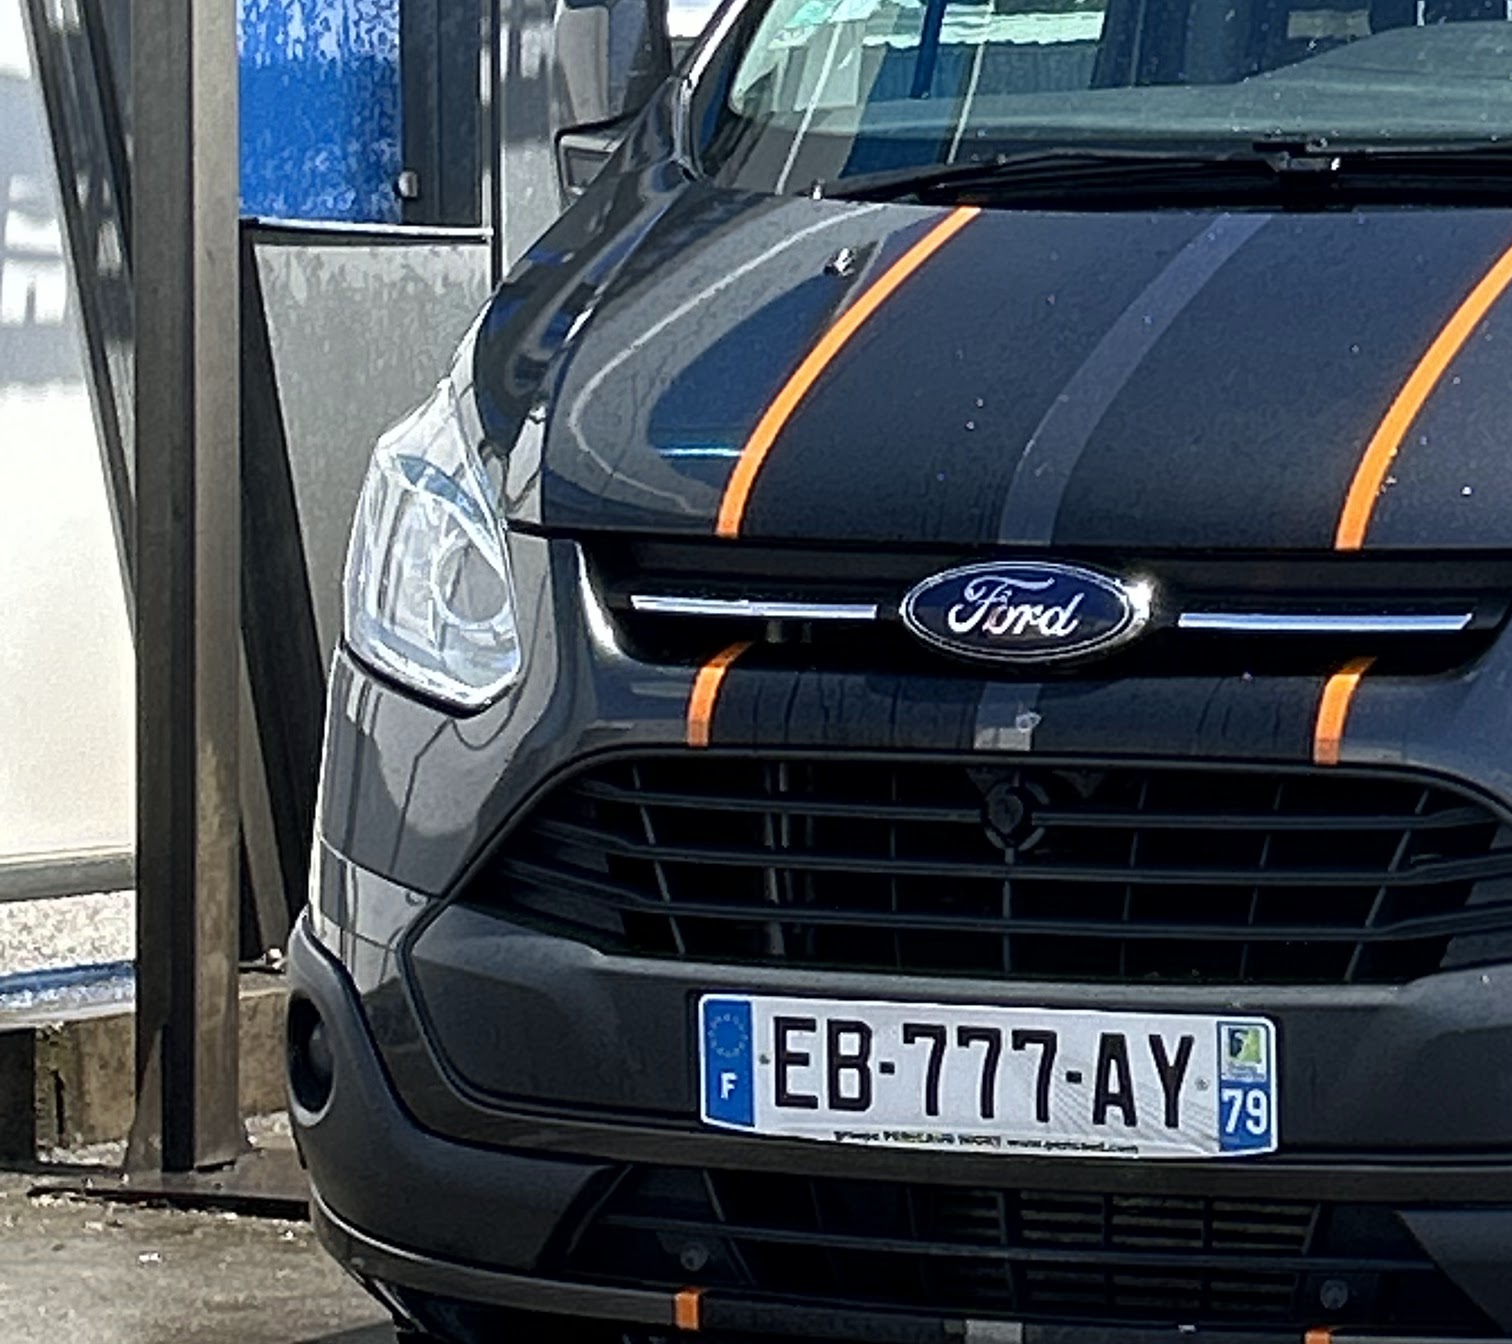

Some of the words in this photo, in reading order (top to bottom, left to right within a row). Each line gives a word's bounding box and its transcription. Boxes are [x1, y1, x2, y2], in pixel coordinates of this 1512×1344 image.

[948, 575, 1085, 637] Ford
[719, 1073, 738, 1100] F
[772, 1015, 1195, 1129] EB-777-AY
[1221, 1087, 1268, 1135] 79
